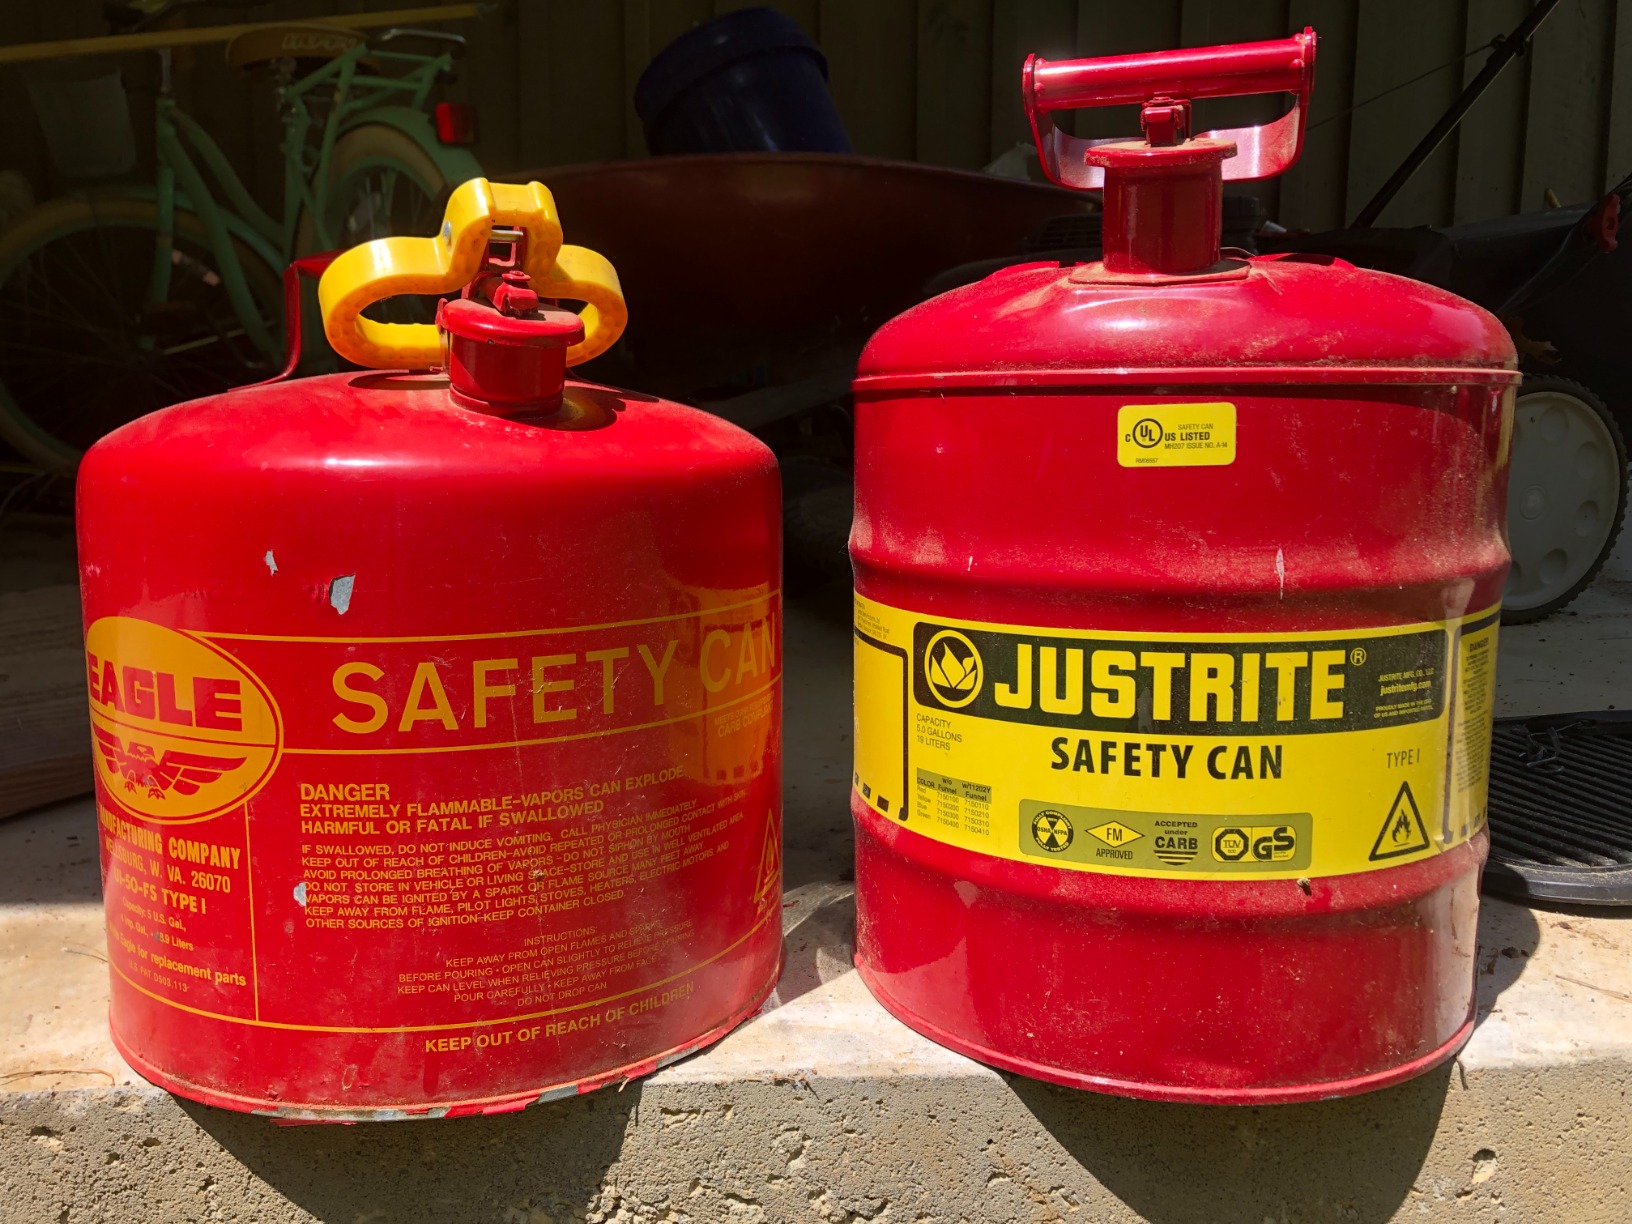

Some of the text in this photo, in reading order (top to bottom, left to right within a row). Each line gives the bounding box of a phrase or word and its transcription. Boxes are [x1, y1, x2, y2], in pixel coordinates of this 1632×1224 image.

[1165, 432, 1210, 442] US LISTED
[332, 640, 679, 734] SAFETY
[700, 612, 775, 692] CAN
[994, 644, 1346, 723] JUSTRITE
[87, 650, 242, 732] EAGLE
[917, 712, 952, 729] CAPACITY
[917, 724, 962, 743] 5.0 GALLONS
[917, 735, 951, 750] 19 LITERS
[1051, 736, 1283, 780] SAFETY CAN
[1387, 750, 1414, 768] TYPE
[300, 765, 684, 818] EXTREMELY FLAMMABLE-VAPORS CAN EXPLODE
[300, 784, 390, 801] DANGER
[916, 777, 987, 802] COLOR Funnel Funnel
[964, 800, 990, 810] 7150110
[301, 800, 604, 834] HARMFUL OR FATAL IF SWALLOWED
[964, 808, 990, 819] 7150210
[964, 816, 990, 828] 7150310
[964, 824, 990, 836] 7150410
[1154, 820, 1198, 828] ACCEPTED
[100, 803, 240, 870] MANUFACTURING COMPANY
[302, 814, 644, 856] IF SWALLOWED, DO NOT INDUCE CALL PHYSICIAN
[302, 803, 714, 868] KEEP OUT OF REACH OF CHILDREN-AVOID REPEATED PROLONGED CONTACT
[304, 824, 690, 880] AVOID PROLONGED BREATHING OF VAPORS NOT SIPHON BY MOUTH
[324, 812, 744, 892] NOT STORE IN VEHICLE OR LIVING AND USE IN WELL VENTILATED AREA
[1106, 828, 1122, 842] FM
[1154, 836, 1198, 850] CARB
[1253, 826, 1295, 860] GS
[1096, 848, 1134, 860] APPROVED
[150, 858, 230, 893] W. VA. 26070
[305, 842, 704, 904] VAPORS CAN BE IGNITED BY A SPARK FLAME SOURCE MANY FEET AWAY
[305, 841, 730, 916] KEEP AWAY FROM FLAME, PILOT HEATERS, ELECTRIC AND
[162, 888, 198, 912] TYPE
[306, 918, 344, 928] OTHER
[348, 919, 404, 928] SOURCES
[408, 918, 424, 928] OF
[518, 899, 580, 918] CONTAINER
[153, 912, 166, 925] U.S.
[172, 936, 194, 952] Liters
[446, 929, 628, 967] KEEP AWAY FROM OPEN FLAMES AND
[138, 944, 246, 986] for replacement parts
[398, 944, 616, 982] BEFORE POURING OPEN CAN SLIGHTLY TO
[398, 953, 625, 994] KEEP CAN LEVEL WHEN RELIEVING PRESSURE
[454, 955, 656, 1002] POUR CAREFULLY KEEP AWAY FROM FACE
[518, 982, 608, 1007] DO NOT DROP CAN
[426, 981, 694, 1052] KEEP OUT OF REACH OF CHILDREN
